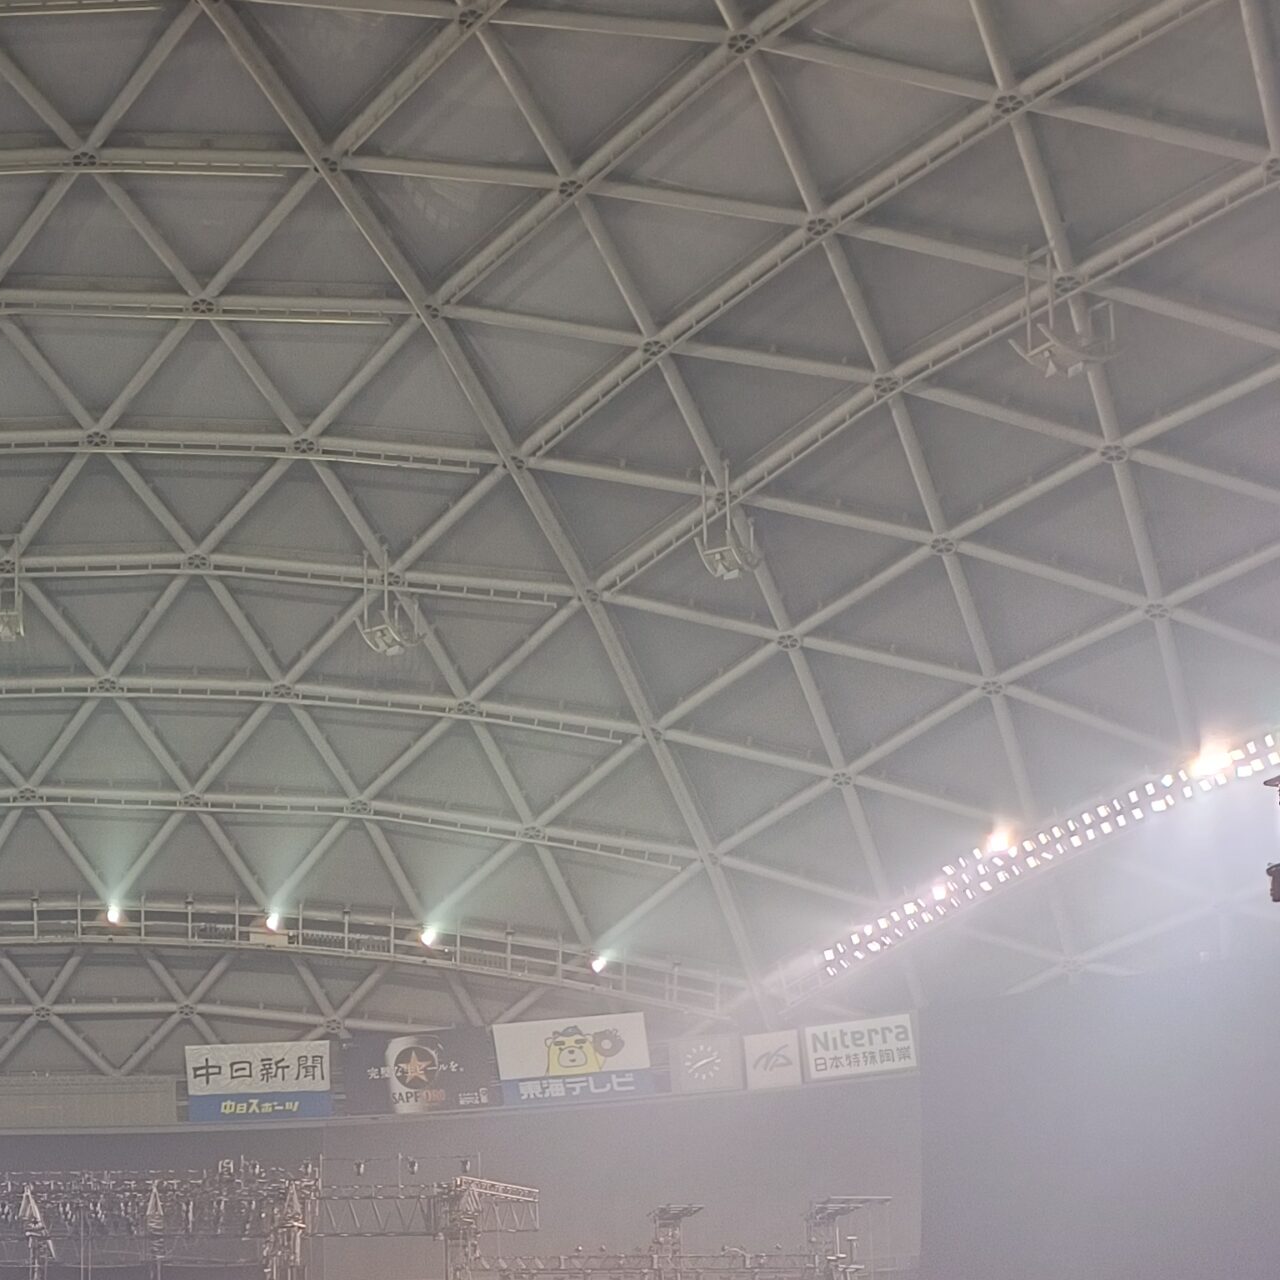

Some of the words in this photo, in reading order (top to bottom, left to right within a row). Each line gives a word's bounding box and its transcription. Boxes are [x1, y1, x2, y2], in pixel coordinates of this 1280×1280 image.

[811, 1024, 910, 1053] Niterra
[191, 1054, 326, 1086] 中日新聞
[814, 1046, 912, 1072] 日本特殊陶業
[518, 1073, 636, 1099] 東海テレビ
[220, 1099, 300, 1114] 中日スポーツ
